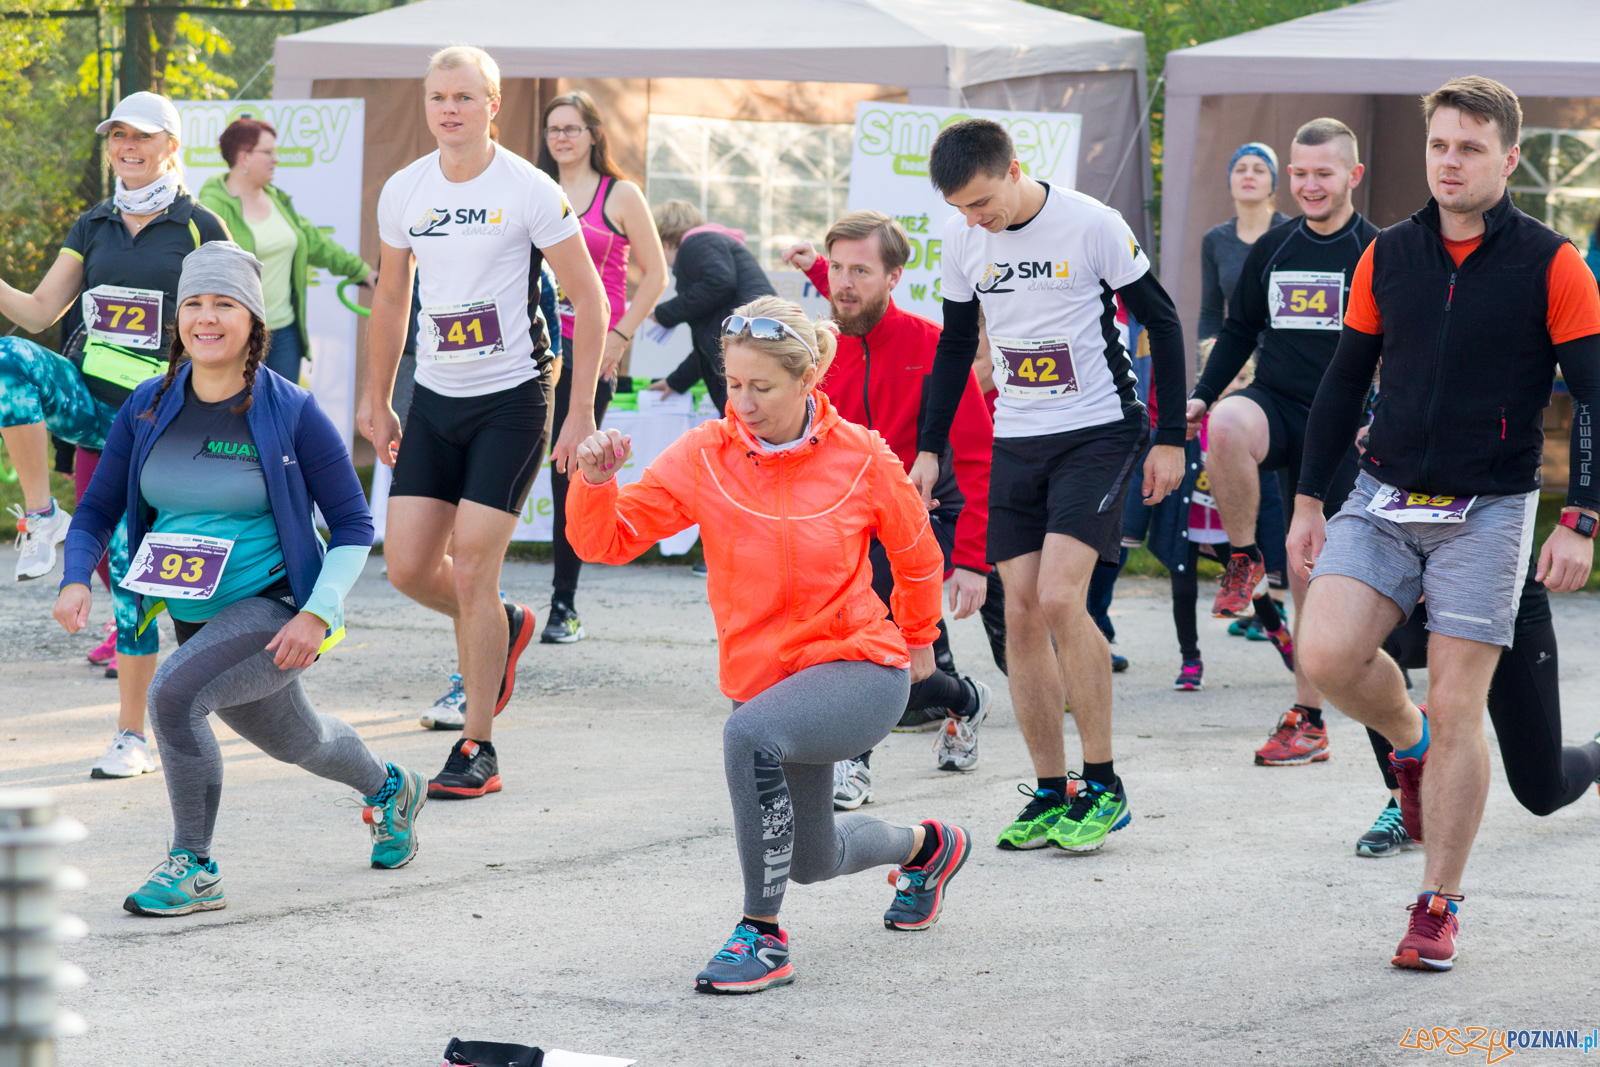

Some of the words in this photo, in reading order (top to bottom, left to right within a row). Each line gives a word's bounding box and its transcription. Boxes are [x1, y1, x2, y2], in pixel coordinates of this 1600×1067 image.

[1027, 270, 1077, 292] RUNNERS!
[1289, 289, 1328, 313] 54
[107, 304, 146, 331] 72
[447, 317, 484, 346] 41
[1017, 356, 1060, 383] 42
[1579, 404, 1593, 487] BRUBECK
[159, 553, 206, 583] 93
[762, 881, 788, 898] READ
